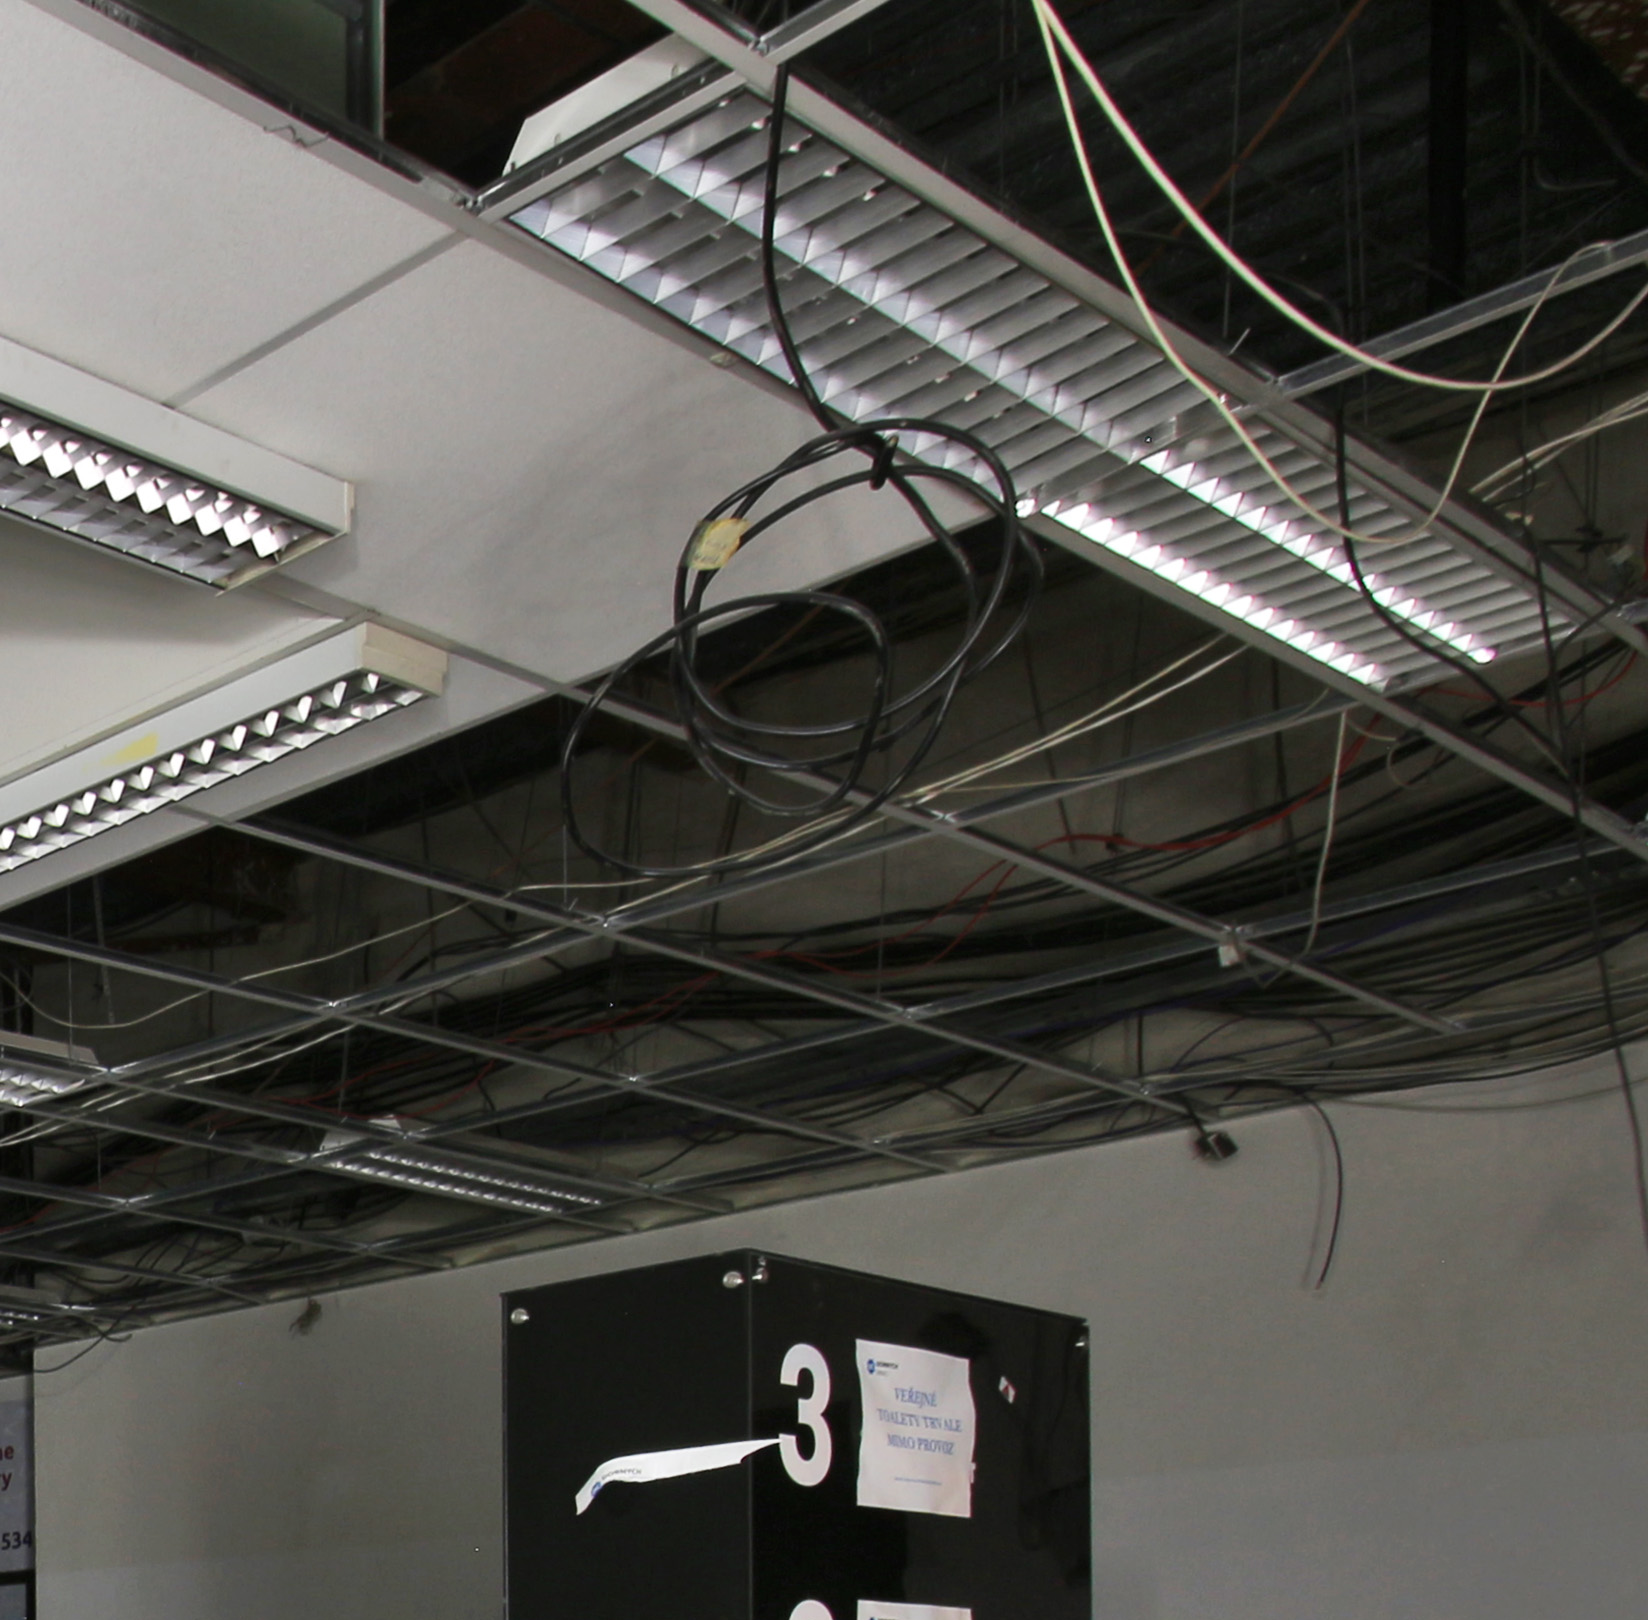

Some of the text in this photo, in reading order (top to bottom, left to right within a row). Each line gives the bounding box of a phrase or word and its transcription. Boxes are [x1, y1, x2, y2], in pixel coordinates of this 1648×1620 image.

[895, 1387, 937, 1408] VEŘEJNÉ
[779, 1343, 832, 1487] 3
[877, 1408, 963, 1433] TOALETY TRVALE
[887, 1434, 956, 1455] MIMO PROVOZ
[1, 1531, 32, 1551] 534
